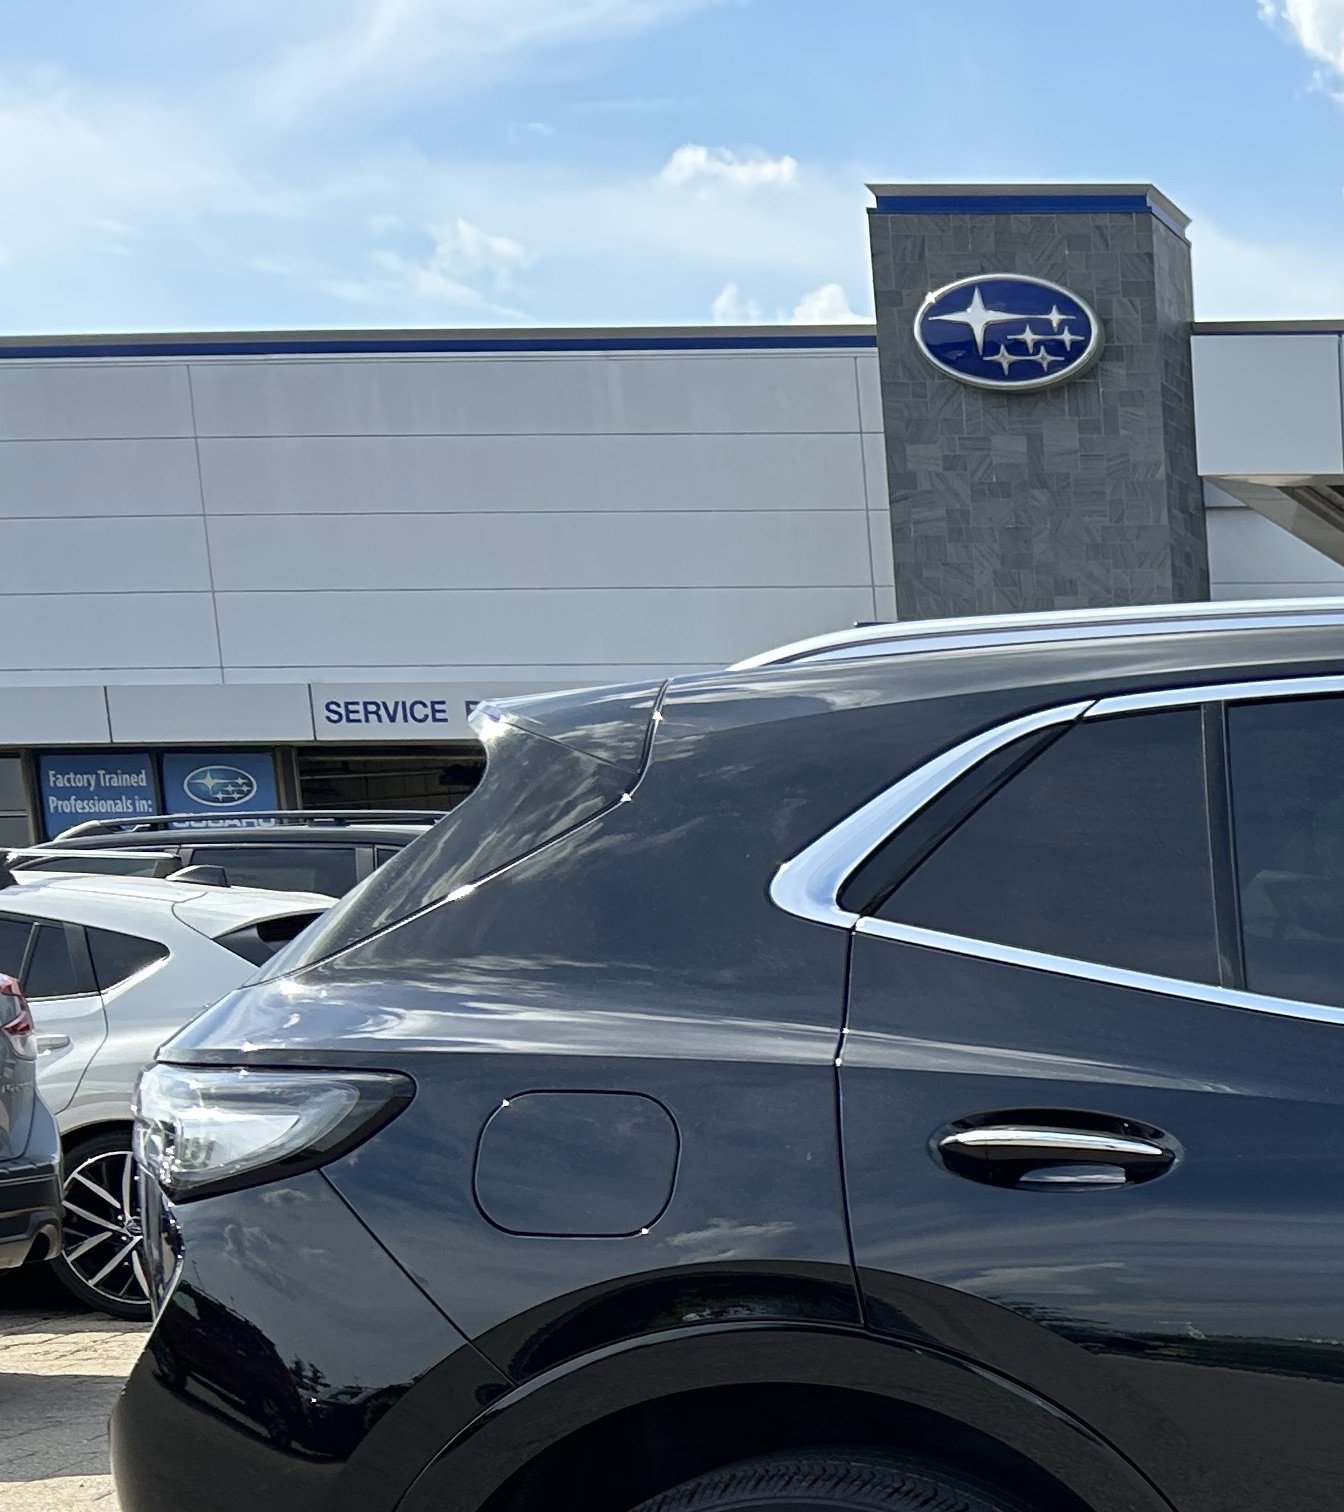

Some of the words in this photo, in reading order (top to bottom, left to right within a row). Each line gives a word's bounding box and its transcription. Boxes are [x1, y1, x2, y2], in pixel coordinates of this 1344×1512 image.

[325, 700, 449, 724] SERVICE
[49, 770, 97, 791] Factory
[100, 769, 147, 787] Trained
[49, 796, 133, 813] Professionals
[135, 796, 153, 813] in:
